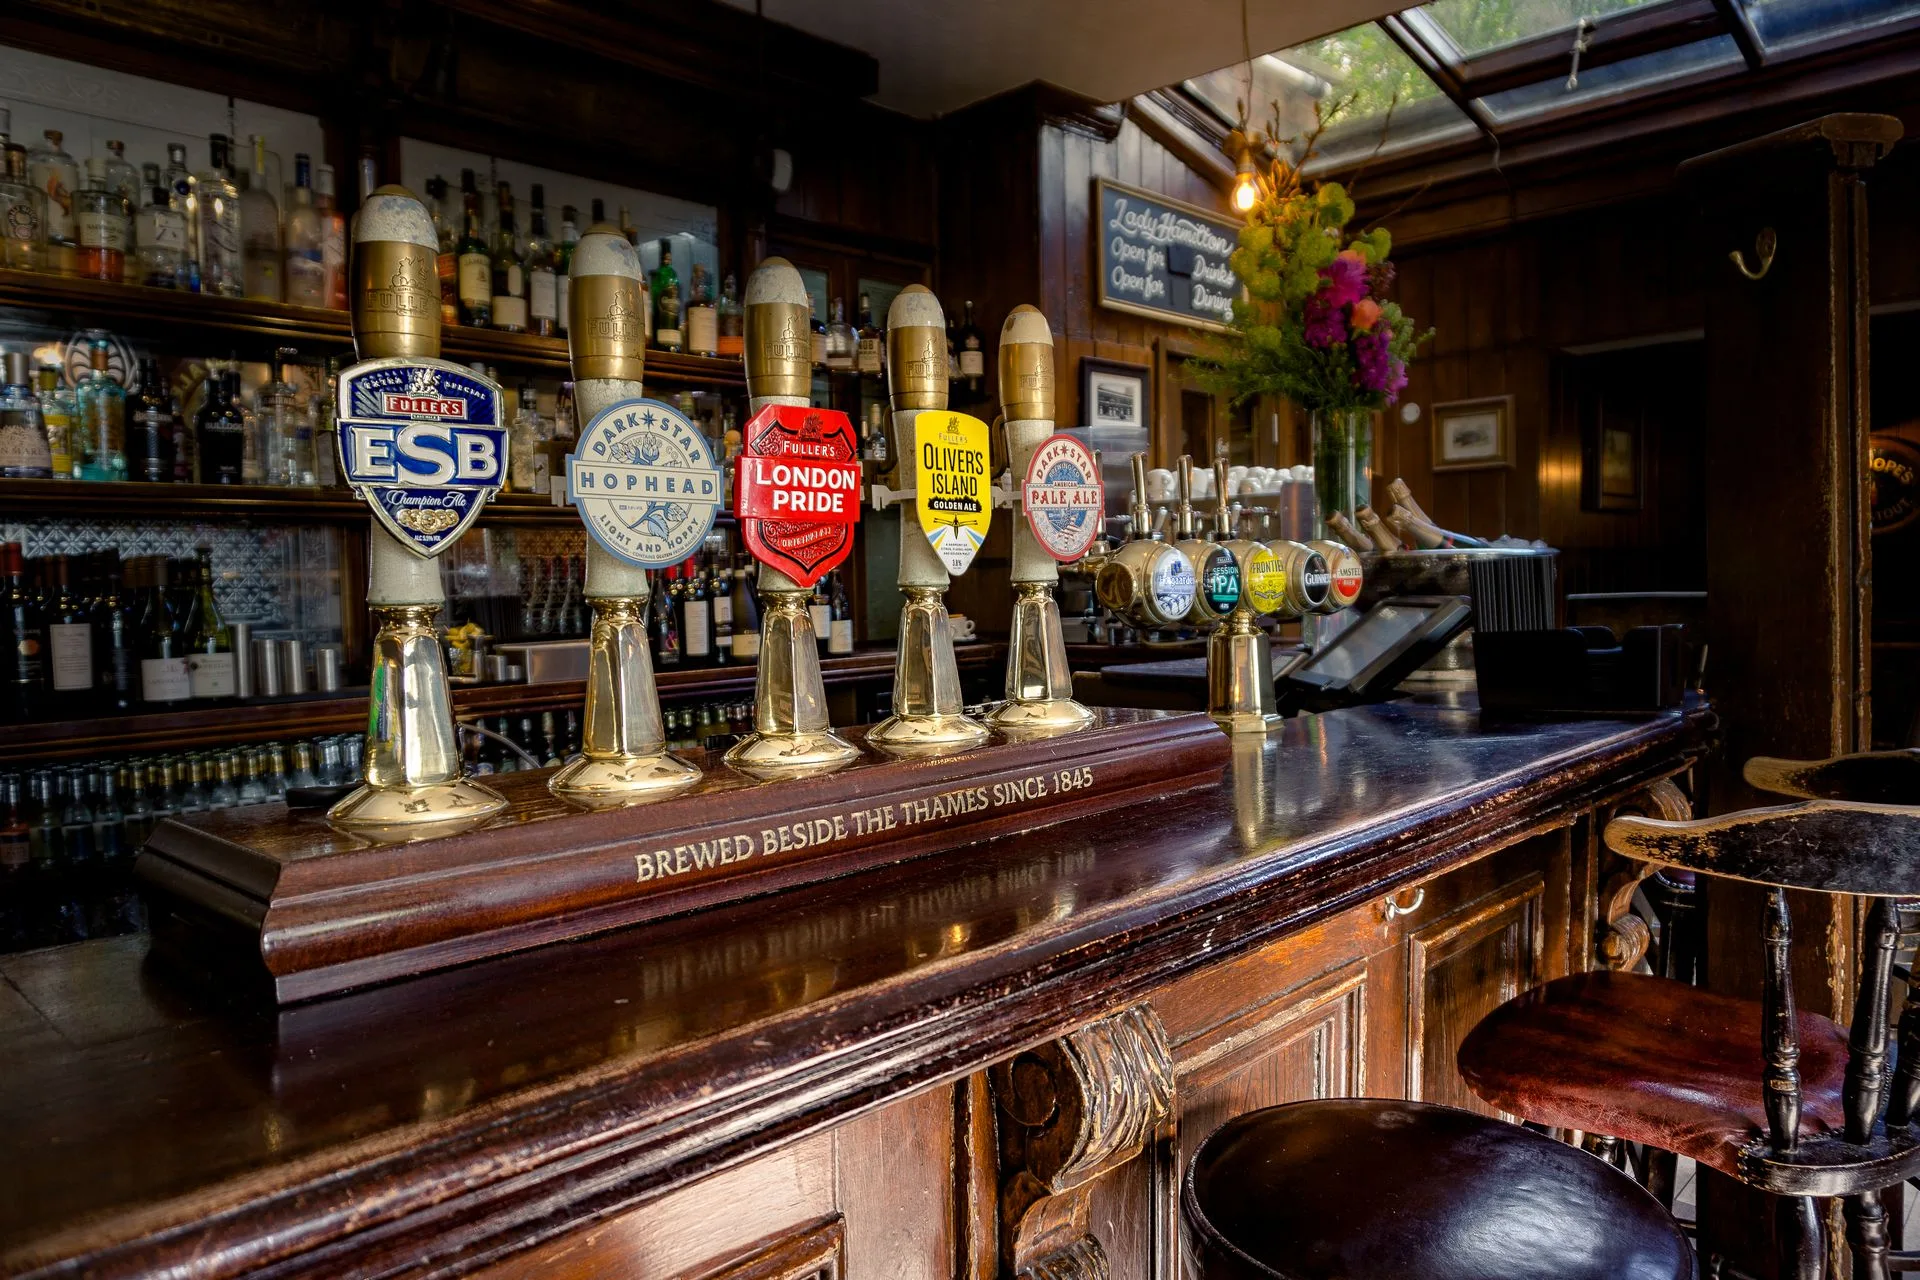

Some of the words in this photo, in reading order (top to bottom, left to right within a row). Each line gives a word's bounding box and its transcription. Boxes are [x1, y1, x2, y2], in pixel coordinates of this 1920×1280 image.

[1110, 199, 1160, 241] Lady
[1158, 212, 1234, 257] Hamilton
[1111, 237, 1145, 262] Open
[1145, 245, 1165, 271] for
[1192, 255, 1236, 288] Drinks
[1112, 266, 1144, 291] Open
[1143, 274, 1165, 299] for
[1192, 284, 1234, 322] Dining
[362, 375, 403, 390] EXTRA
[443, 380, 487, 401] SPECIAL
[388, 397, 461, 415] FULLER'S
[592, 412, 640, 456] DARK
[660, 417, 701, 464] STAR
[351, 423, 499, 485] ESB
[783, 441, 835, 457] FULLER'S
[924, 443, 984, 475] OLIVER'S
[1036, 446, 1060, 480] DARK
[1071, 448, 1092, 480] STAR
[580, 471, 713, 495] HOPHEAD
[756, 464, 855, 490] LONDON
[932, 473, 978, 496] ISLAND
[386, 490, 441, 510] Champion
[442, 491, 467, 508] Ale
[773, 489, 844, 513] PRIDE
[934, 500, 963, 510] GOLDEN
[963, 502, 977, 511] ALE
[1032, 490, 1068, 505] PALE
[1073, 490, 1098, 505] ALE
[600, 514, 631, 546] LIGHT
[636, 542, 661, 552] AND
[668, 518, 699, 549] HOPPY
[1213, 567, 1239, 575] SESSION
[1340, 568, 1360, 577] AMSTEL
[1213, 575, 1238, 593] IPA
[636, 833, 754, 884] BREWED
[762, 814, 849, 857] BESIDE
[851, 804, 898, 837] THE
[900, 786, 989, 827] THAMES
[992, 775, 1048, 807] SINCE
[1052, 766, 1095, 793] 1845
